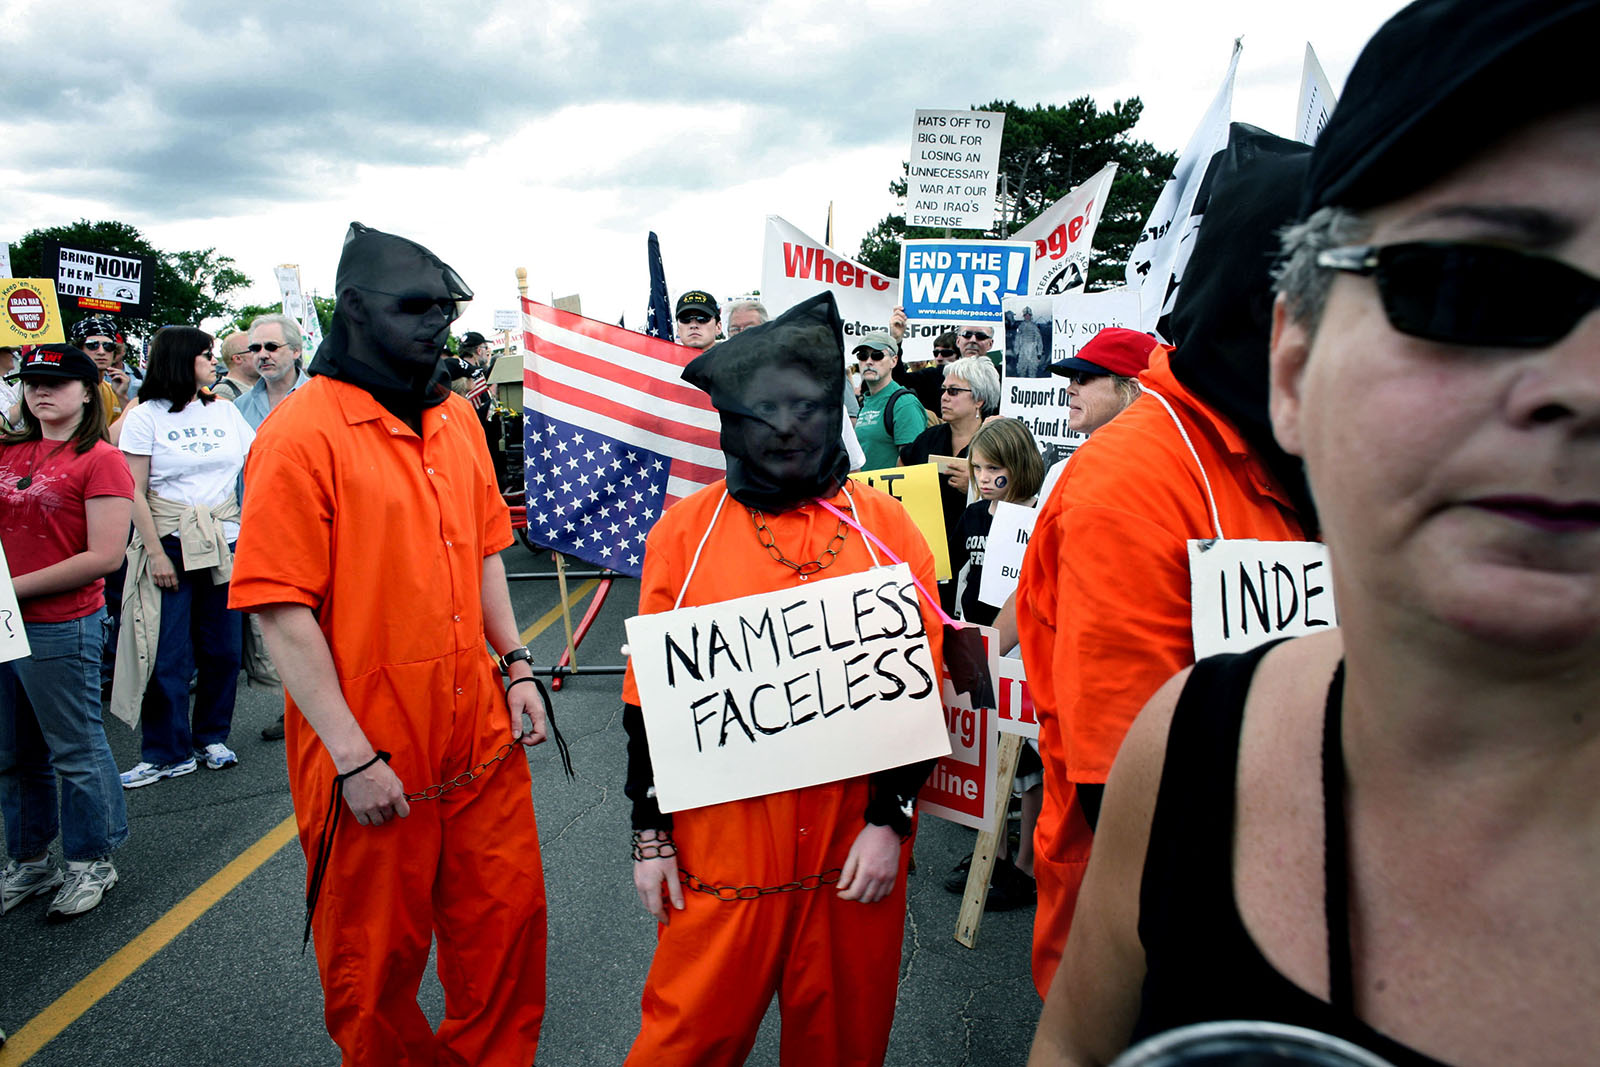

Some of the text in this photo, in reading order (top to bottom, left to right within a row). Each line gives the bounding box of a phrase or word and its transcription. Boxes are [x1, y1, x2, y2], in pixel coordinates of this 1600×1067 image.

[917, 116, 991, 129] HATS OFF TO
[917, 133, 982, 146] BIG OIL FOR
[921, 150, 981, 163] LOSING AN
[911, 166, 990, 180] UNNECESSARY
[919, 184, 987, 196] WAR AT OUR
[915, 199, 979, 212] AND IRAQ'S
[913, 215, 963, 226] EXPENSE
[60, 250, 94, 266] BRING
[909, 252, 1002, 271] END THE
[60, 266, 93, 282] THEM
[95, 256, 141, 280] NOW
[59, 282, 92, 297] HOME
[10, 298, 28, 306] IRAQ
[17, 313, 41, 322] WRONG
[24, 321, 38, 329] WAY
[1054, 319, 1077, 338] My
[1081, 322, 1106, 334] son
[1054, 343, 1066, 359] in
[1011, 385, 1055, 408] Support
[167, 427, 226, 441] OHIO
[665, 581, 927, 688] NAMELESS
[689, 643, 933, 753] FACELESS
